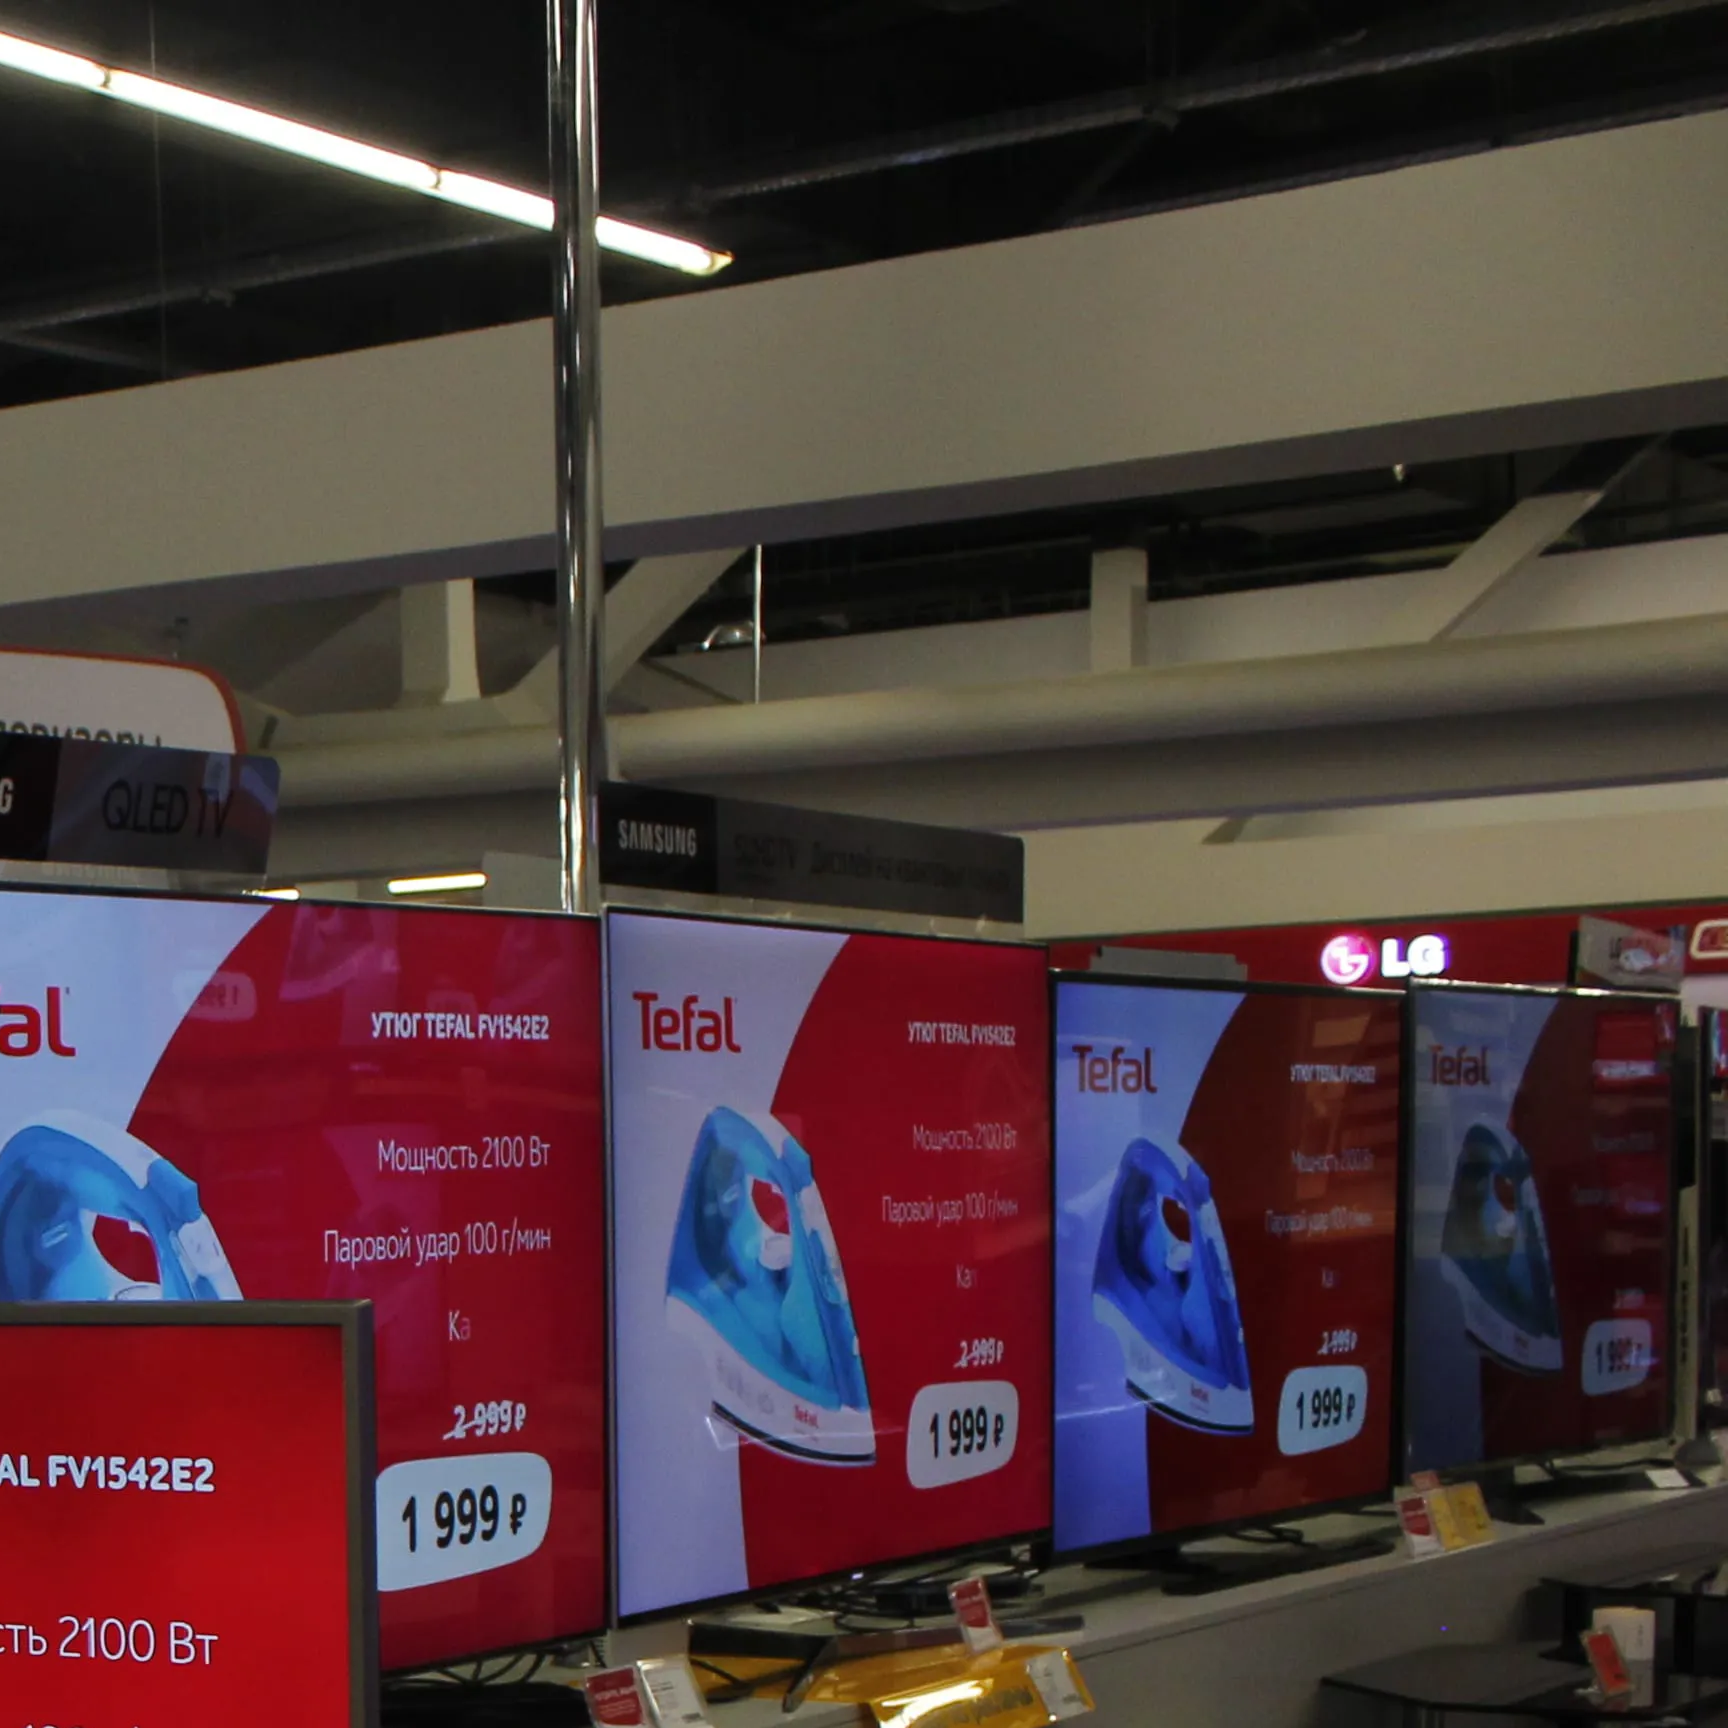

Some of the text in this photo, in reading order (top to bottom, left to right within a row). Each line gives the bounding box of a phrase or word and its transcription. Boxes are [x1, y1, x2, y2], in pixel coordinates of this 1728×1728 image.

[101, 779, 189, 836] QLED
[196, 786, 236, 839] TV
[617, 817, 698, 858] SAMSUNG
[1380, 934, 1450, 978] LG
[371, 1011, 550, 1041] УТЮГ TEFAL FV1542E2
[633, 991, 741, 1054] Tefal
[908, 1021, 1016, 1047] УТЮГ TEFAL FV1542E2
[1072, 1044, 1158, 1094] Tefal
[1430, 1045, 1492, 1087] Tefal
[377, 1136, 551, 1175] Мощность 2100 Вт
[913, 1123, 1002, 1153] Мощность 2100
[882, 1195, 935, 1229] Паровой
[936, 1198, 964, 1228] удар
[965, 1193, 986, 1220] 100
[323, 1215, 552, 1268] Паровой удар 100 г/мин
[949, 1405, 988, 1457] 999
[47, 1453, 216, 1494] FV1542E2
[434, 1485, 500, 1548] 999
[58, 1614, 156, 1663] 2100
[168, 1623, 220, 1666] Вт
